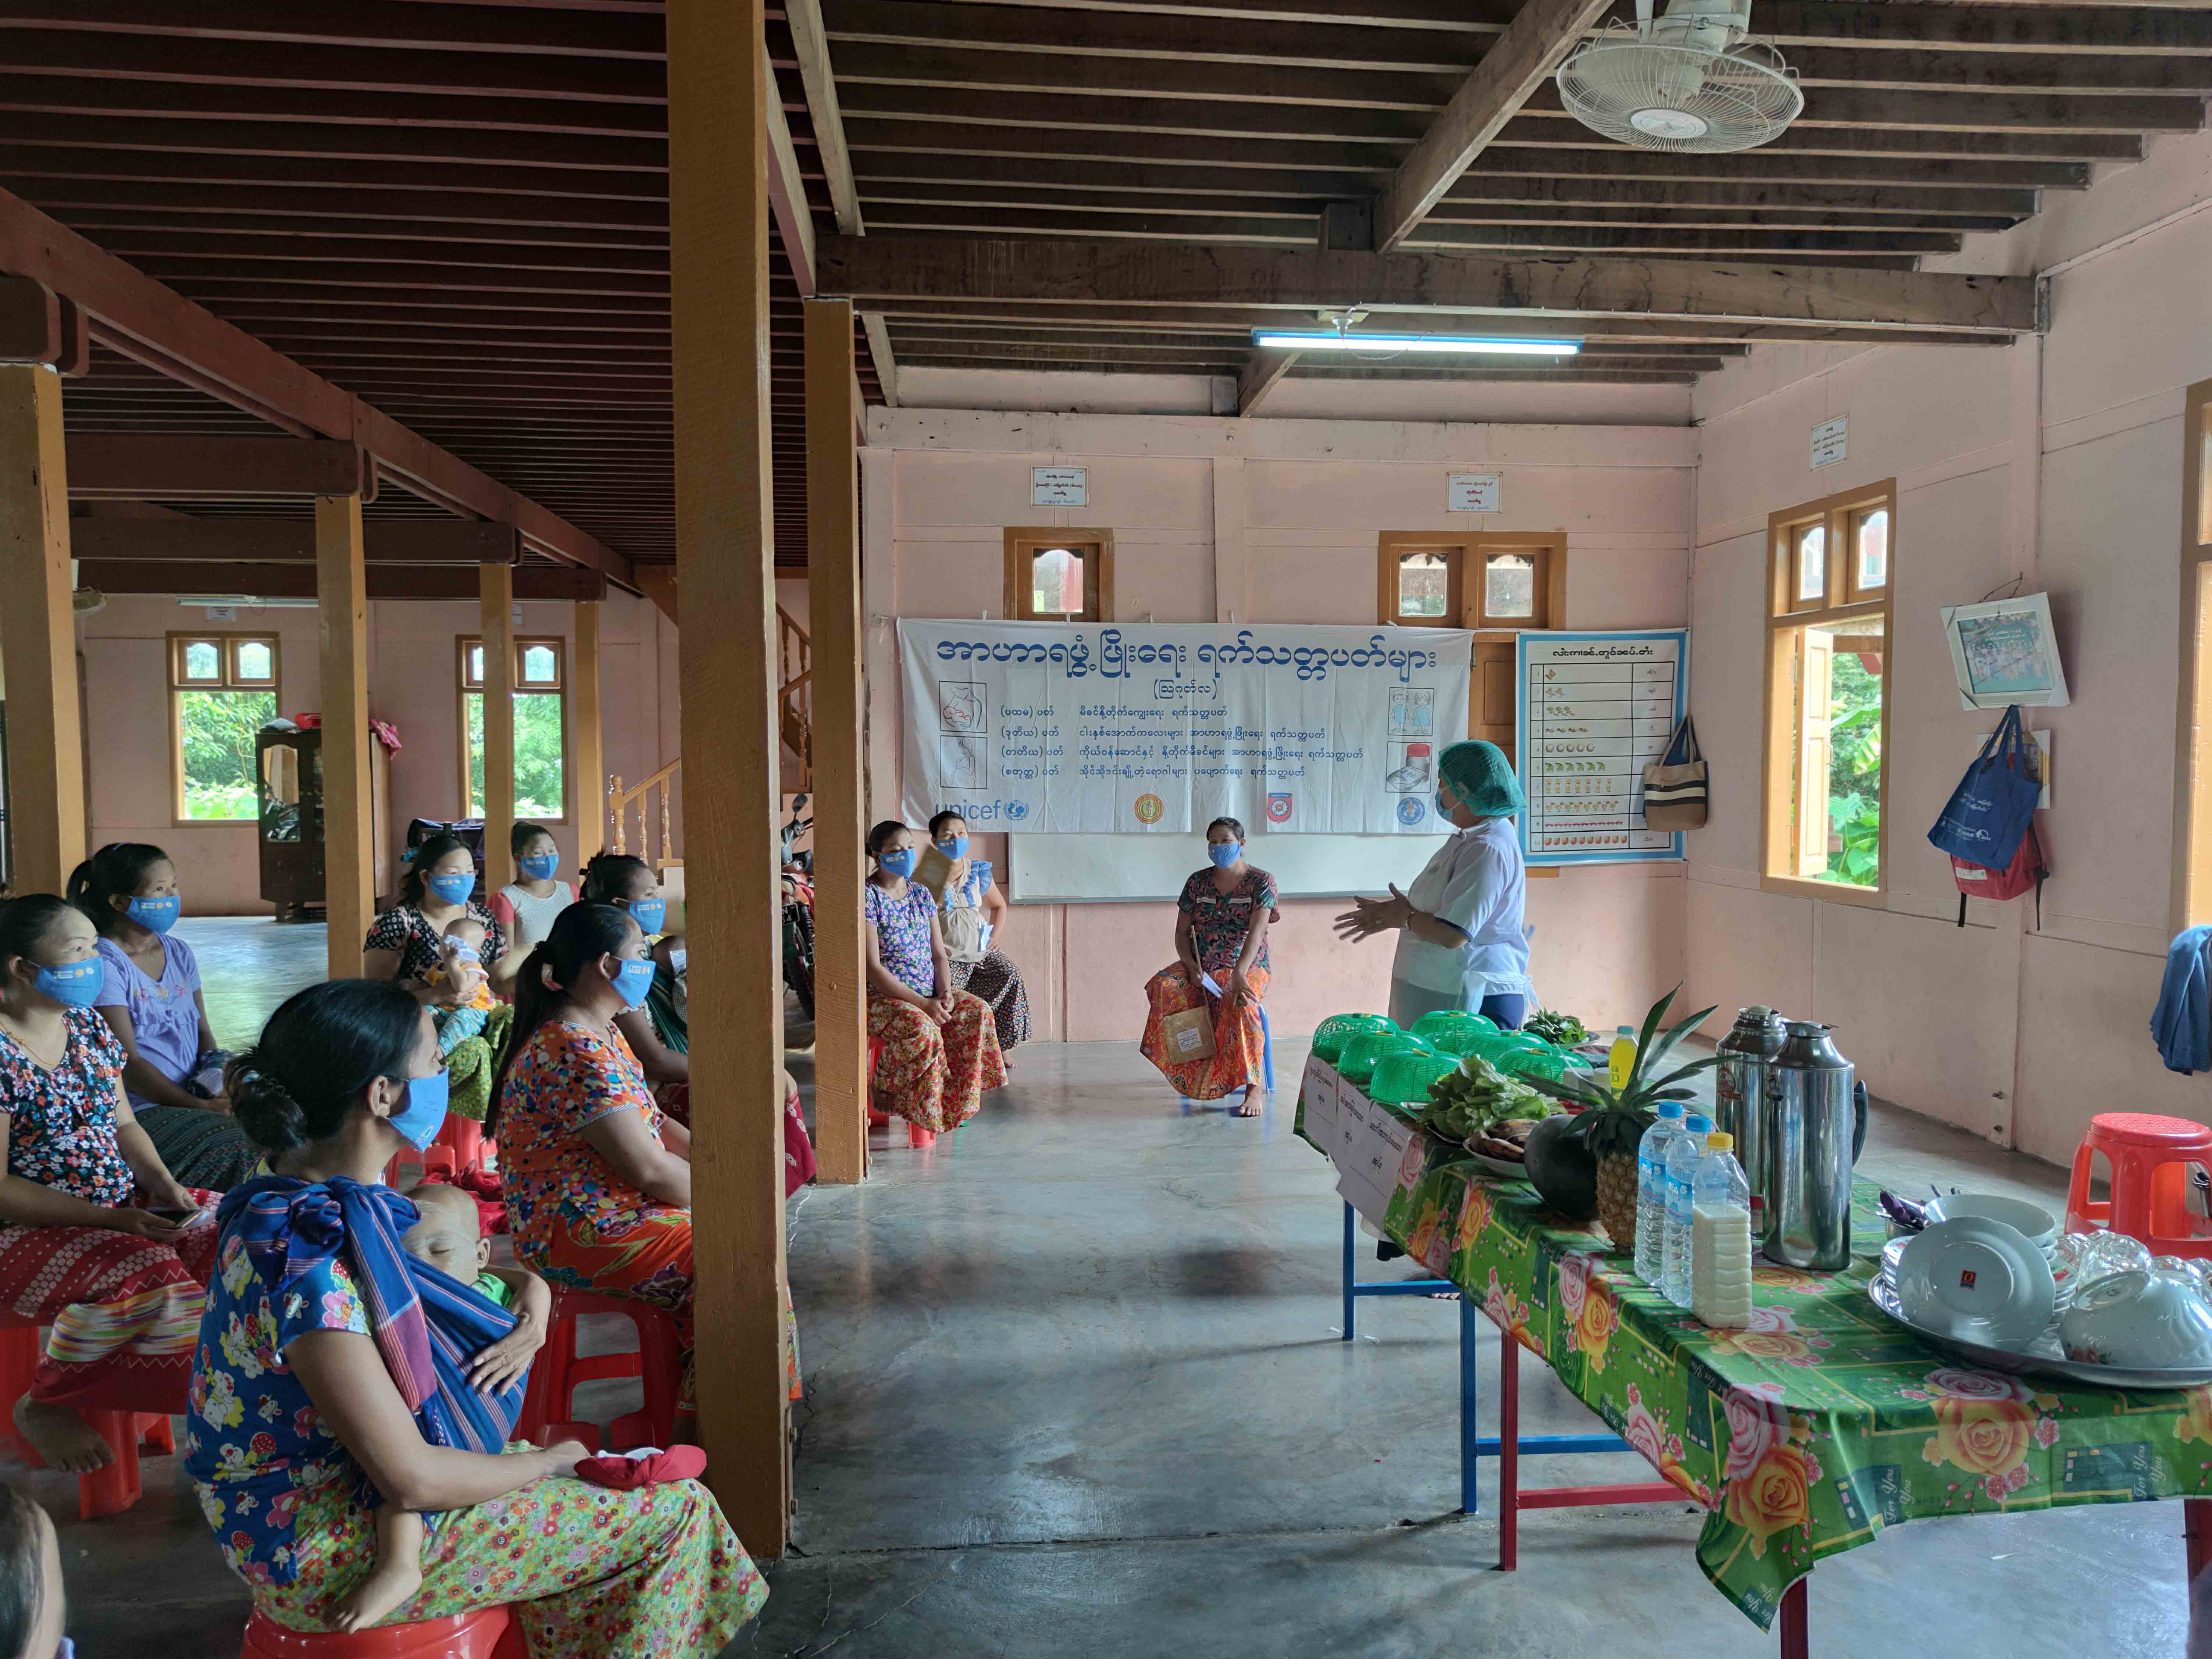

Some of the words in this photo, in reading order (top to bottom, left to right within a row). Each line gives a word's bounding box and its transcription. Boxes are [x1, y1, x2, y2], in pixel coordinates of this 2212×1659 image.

[937, 629, 1186, 678] အာဟာရဖွံ့ဖြိုးရေး
[1198, 630, 1437, 683] ရက်သတ္တပတ်များ
[1001, 705, 1032, 718] (ပထမ)
[1037, 705, 1054, 716] ပတ်
[1172, 705, 1227, 720] ရက်သတ္တပတ်
[1002, 725, 1038, 740] (ဒုတိယ)
[1042, 726, 1059, 736] ပတ်
[1270, 727, 1325, 742] ရက်သတ္တပတ်
[1002, 745, 1043, 756] (တတိယ)
[1047, 745, 1063, 756] ပတ်
[1309, 748, 1363, 761] ရက်သတ္တပတ်
[1042, 765, 1059, 775] ပတ်
[1194, 764, 1242, 778] ပပျောက်ရေး
[1251, 765, 1305, 779] ရက်သတ္တပတ်
[2133, 1444, 2148, 1470] You
[1881, 1468, 1898, 1494] You
[1745, 1593, 1762, 1613] You
